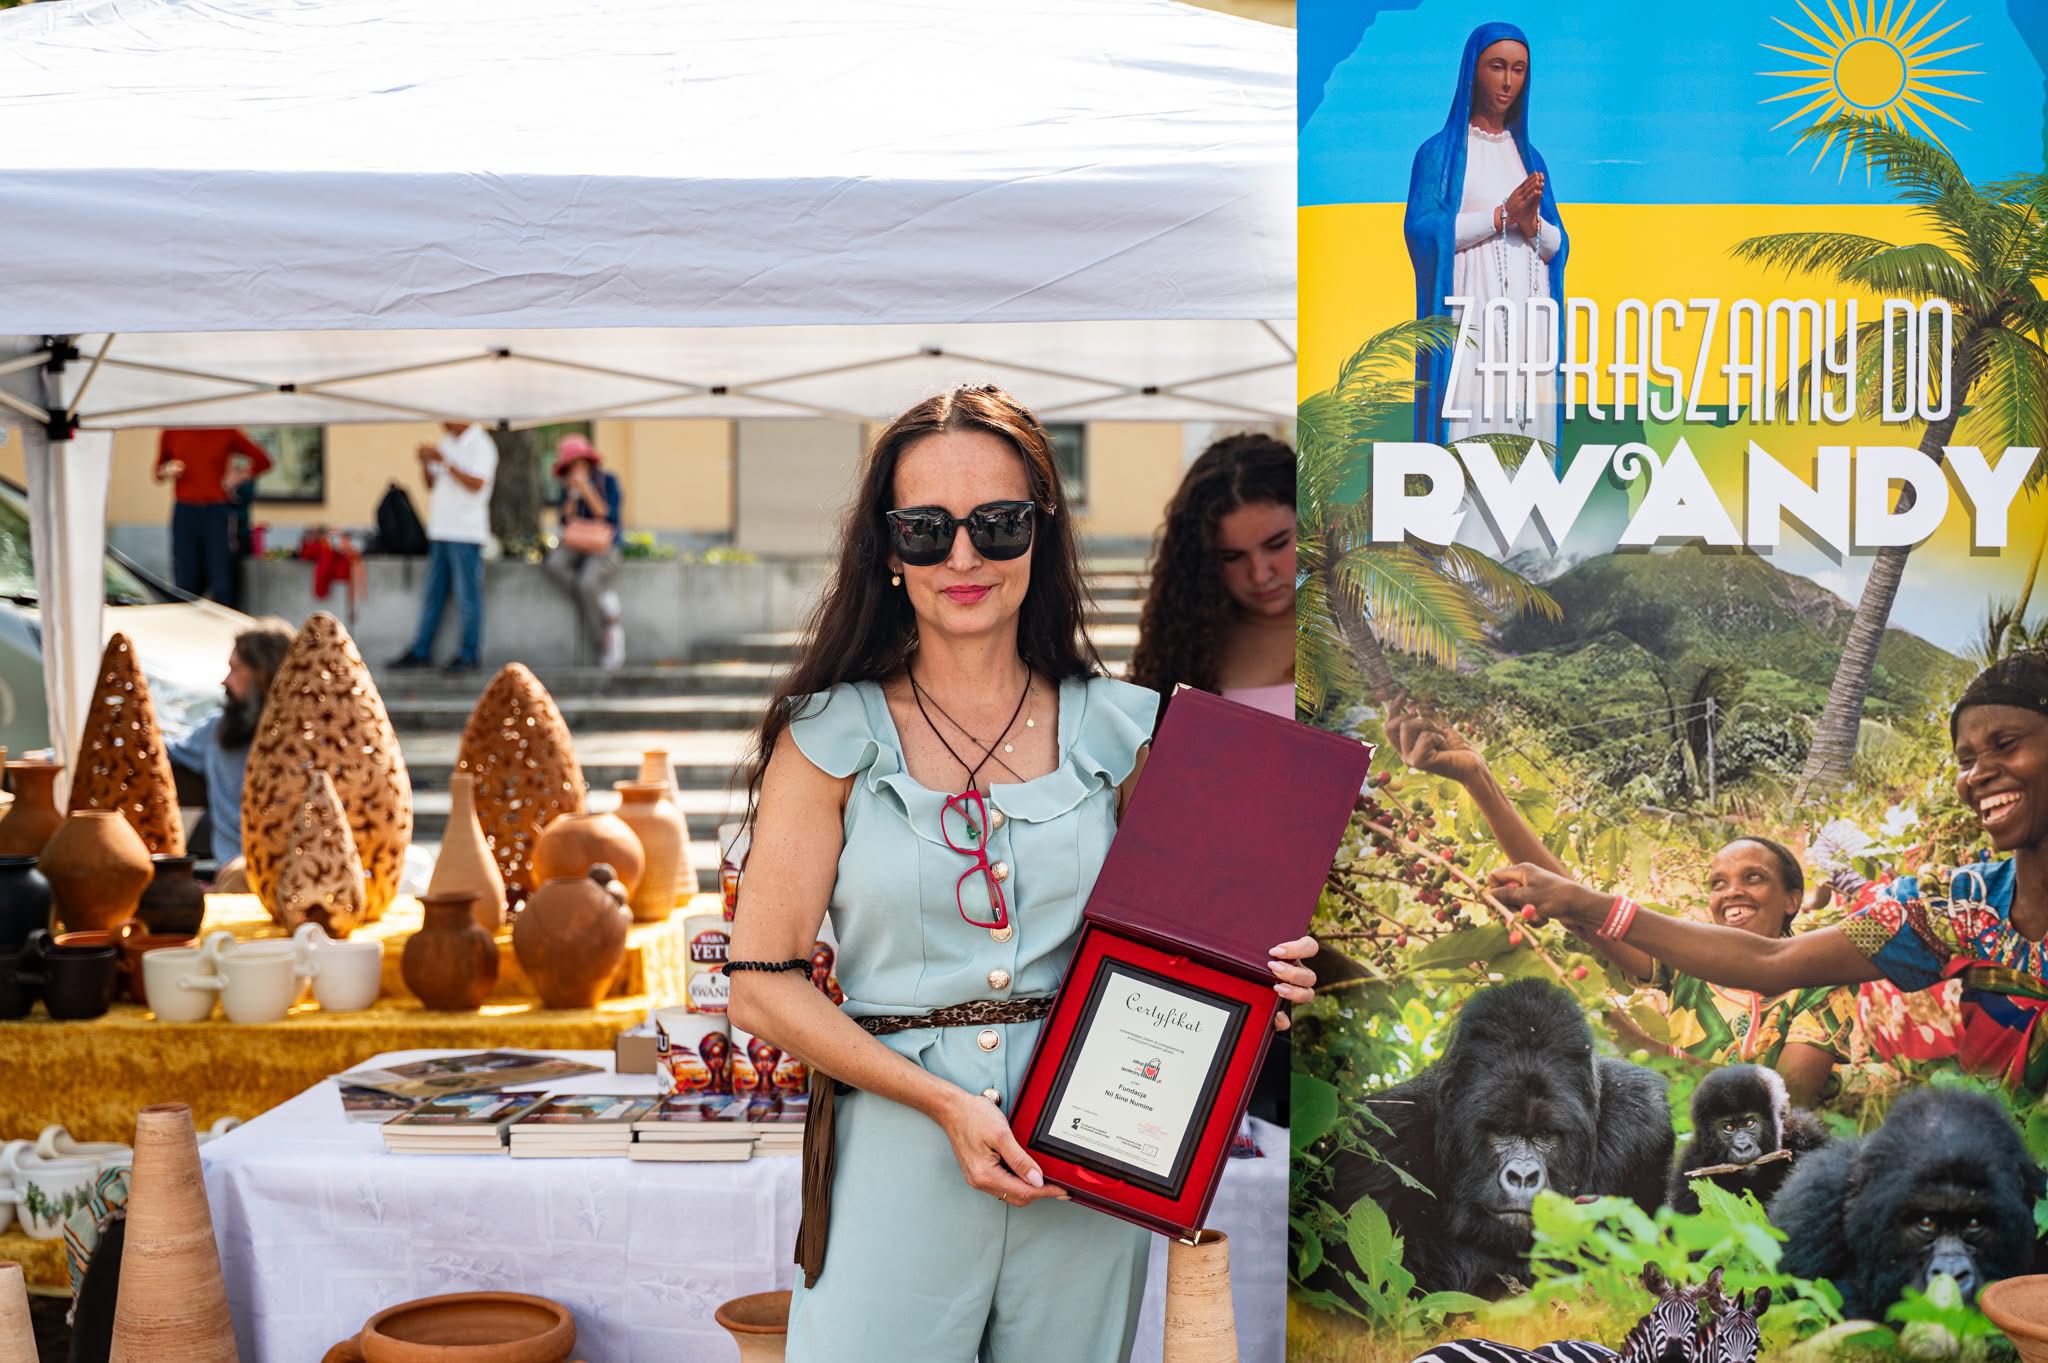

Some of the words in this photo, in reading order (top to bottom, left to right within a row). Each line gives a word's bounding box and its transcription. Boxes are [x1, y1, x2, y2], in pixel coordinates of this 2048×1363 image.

[1442, 296, 1857, 422] ZAPRASZAMY
[1883, 298, 1953, 422] DO
[1372, 436, 2041, 557] RWANDY
[1126, 992, 1201, 1033] Certyfikat
[1114, 1093, 1129, 1103] Sine
[1129, 1098, 1154, 1112] Numine
[1118, 1083, 1147, 1099] Fundacja
